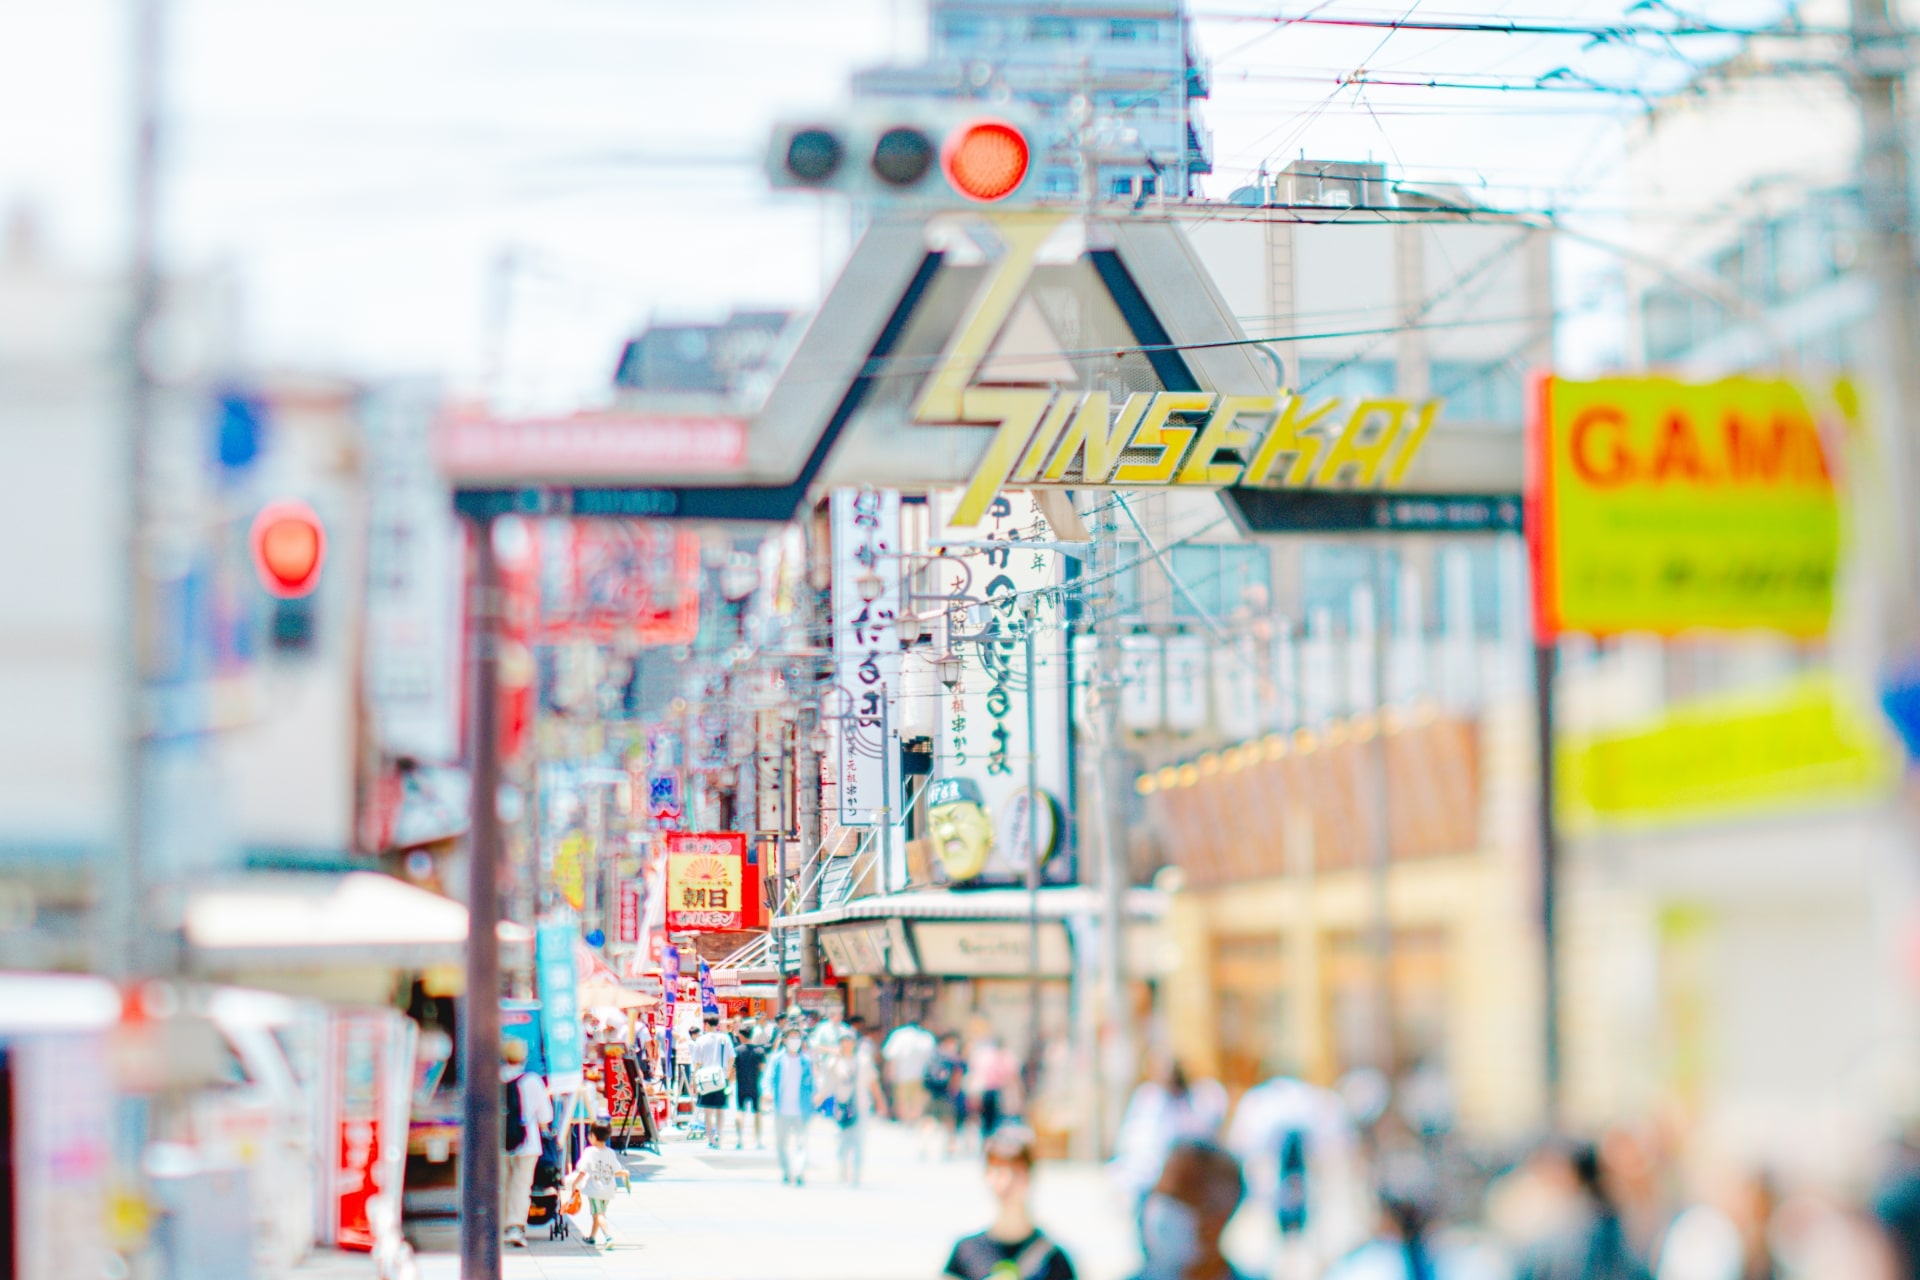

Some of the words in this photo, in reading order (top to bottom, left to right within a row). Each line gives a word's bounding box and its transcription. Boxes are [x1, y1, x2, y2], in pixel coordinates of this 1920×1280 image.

[851, 490, 893, 727] 串かだるま
[682, 888, 728, 909] 朝日
[678, 912, 734, 927] ホルモン
